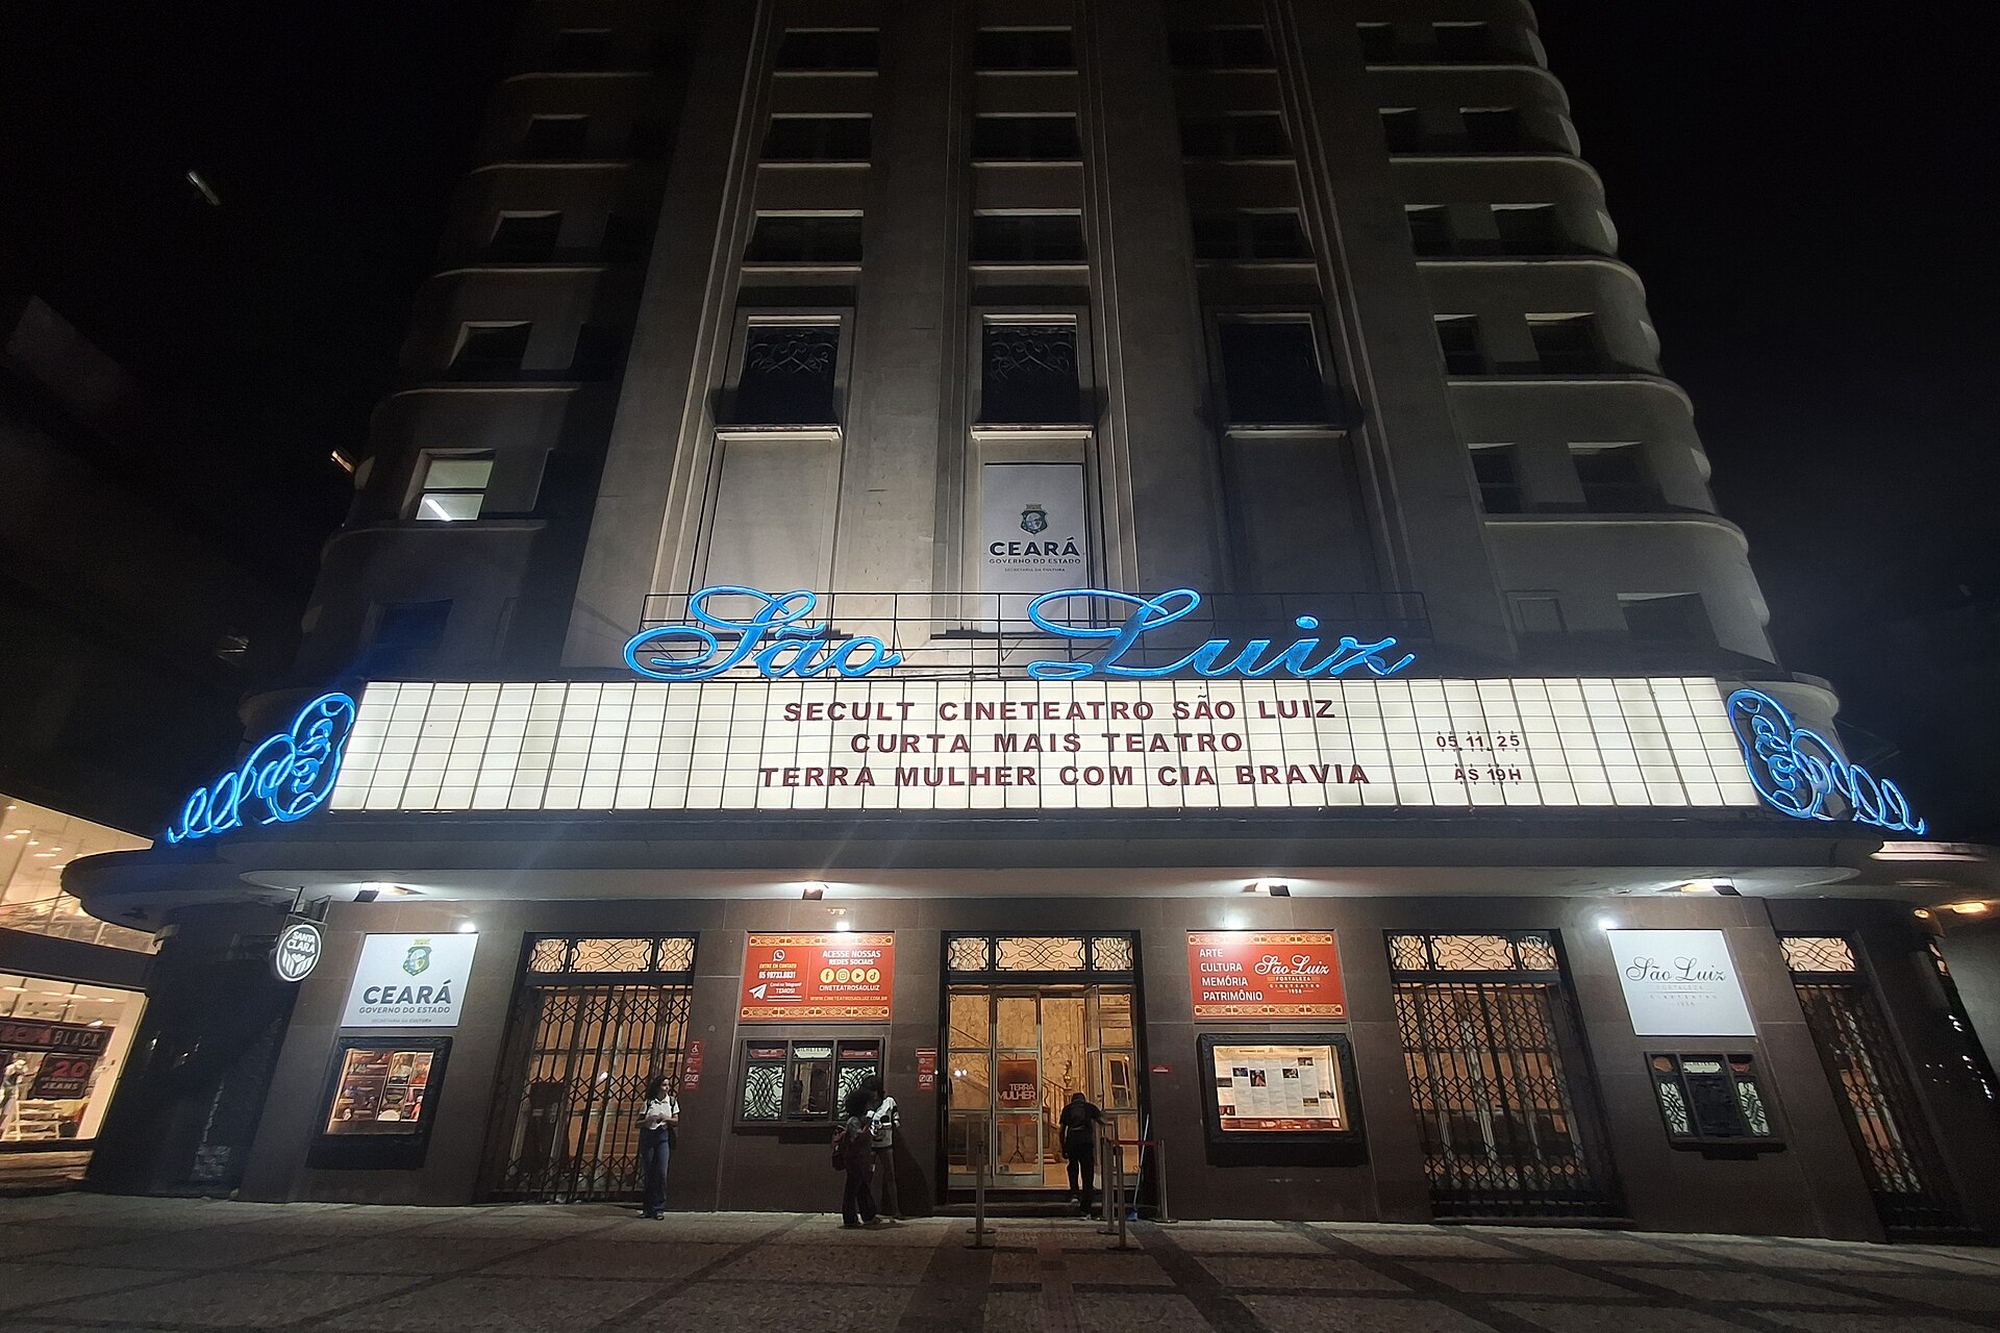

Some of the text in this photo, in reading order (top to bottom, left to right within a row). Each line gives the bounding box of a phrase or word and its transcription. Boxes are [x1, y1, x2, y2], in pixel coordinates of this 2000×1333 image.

[989, 536, 1080, 556] CEARÁ
[623, 584, 1416, 680] São Luiz
[783, 694, 1336, 721] SECULT CINETEATRO SÃO LUIZ
[851, 732, 1243, 753] CURTA MAIS TEATRO
[759, 764, 1370, 787] TERRA MULHER COM CIA BRAVIA
[1486, 768, 1522, 781] 19H
[291, 931, 316, 943] SANTA
[287, 940, 315, 953] CLARA
[1199, 948, 1223, 957] ARTE
[822, 950, 881, 958] ACESSE NOSSAS
[1200, 963, 1243, 972] CULTURA
[1254, 955, 1329, 975] São Luiz
[1625, 956, 1726, 981] São Luiz
[1202, 975, 1248, 986] MEMÓRIA
[363, 979, 451, 1004] CEARÁ
[1203, 989, 1263, 1001] PATRIMÔNIO
[359, 1006, 451, 1014] GOVERNO DO ESTADO
[53, 1030, 99, 1047] BLACK
[52, 1060, 89, 1078] 20
[1008, 1083, 1035, 1091] TERRA
[998, 1091, 1036, 1100] MULHER
